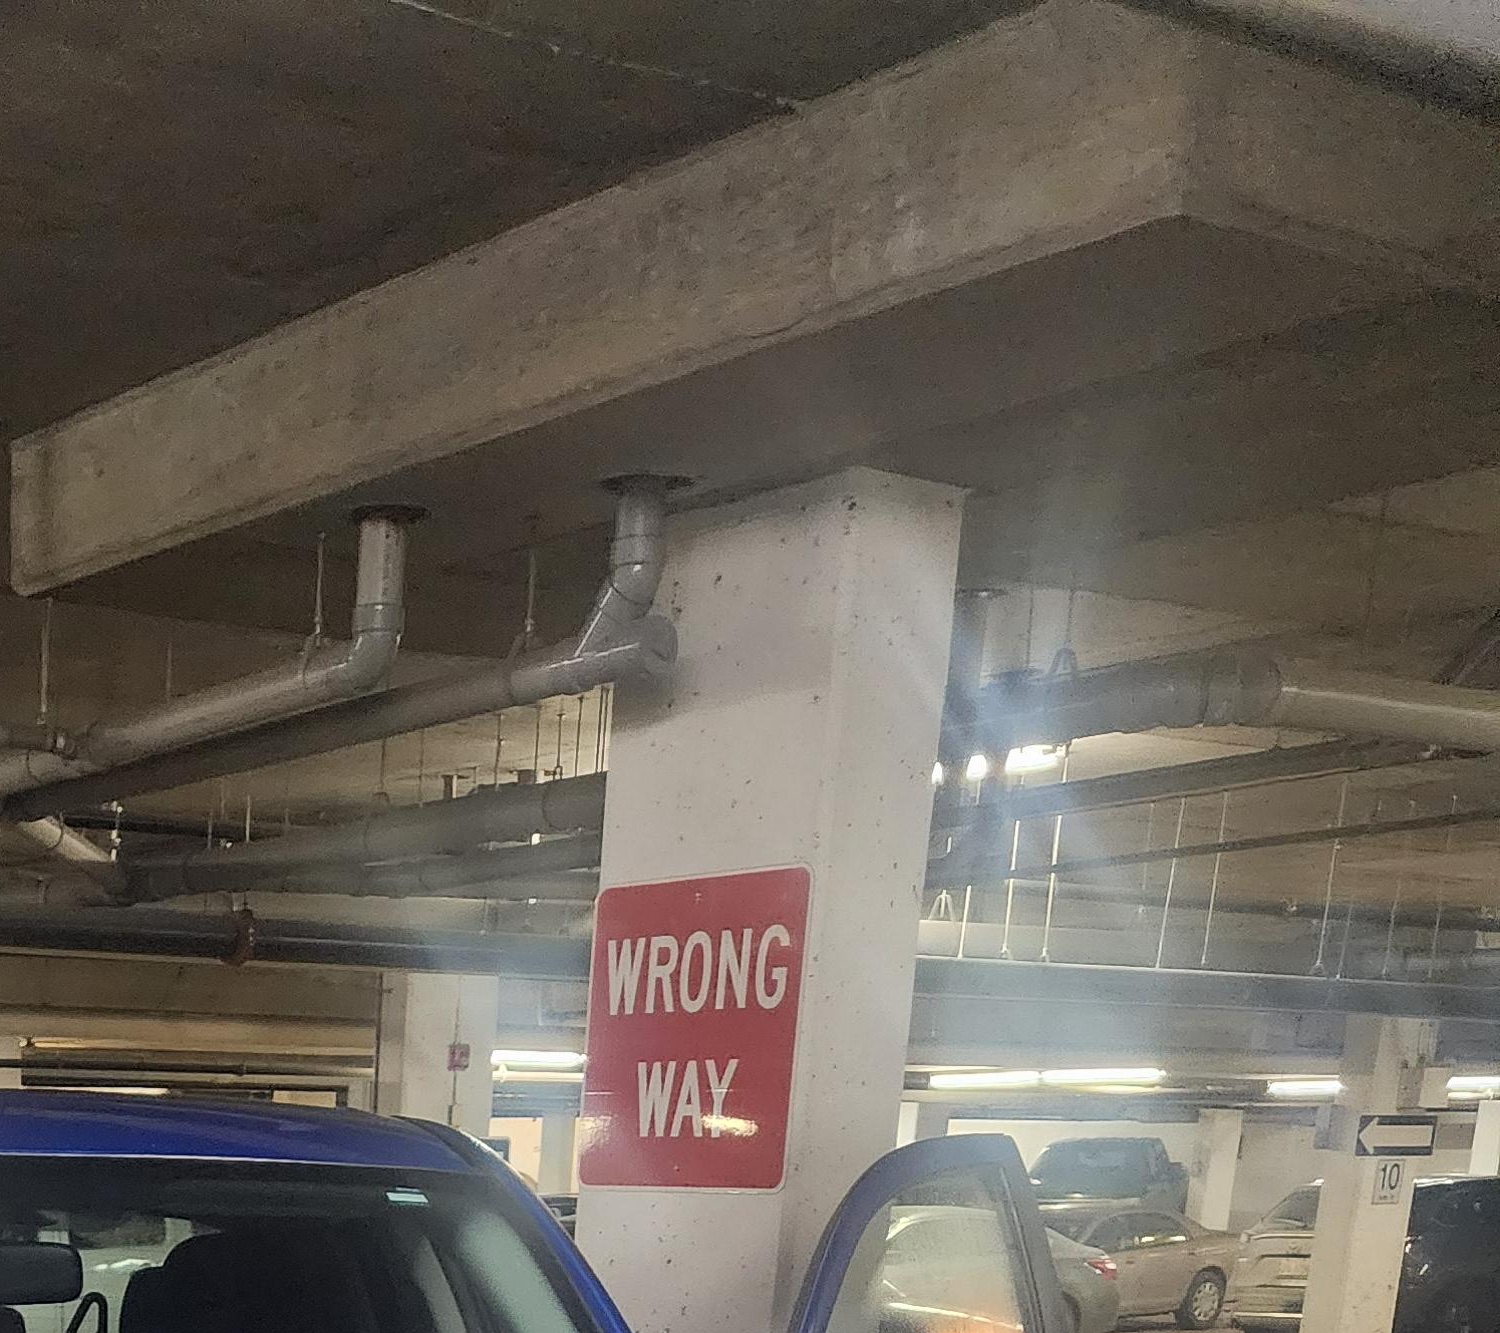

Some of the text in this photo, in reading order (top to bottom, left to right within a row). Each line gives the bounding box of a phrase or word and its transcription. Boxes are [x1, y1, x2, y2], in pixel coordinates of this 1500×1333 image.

[607, 924, 791, 1016] WRONG
[637, 1058, 740, 1138] WAY
[1381, 1163, 1400, 1190] 10
